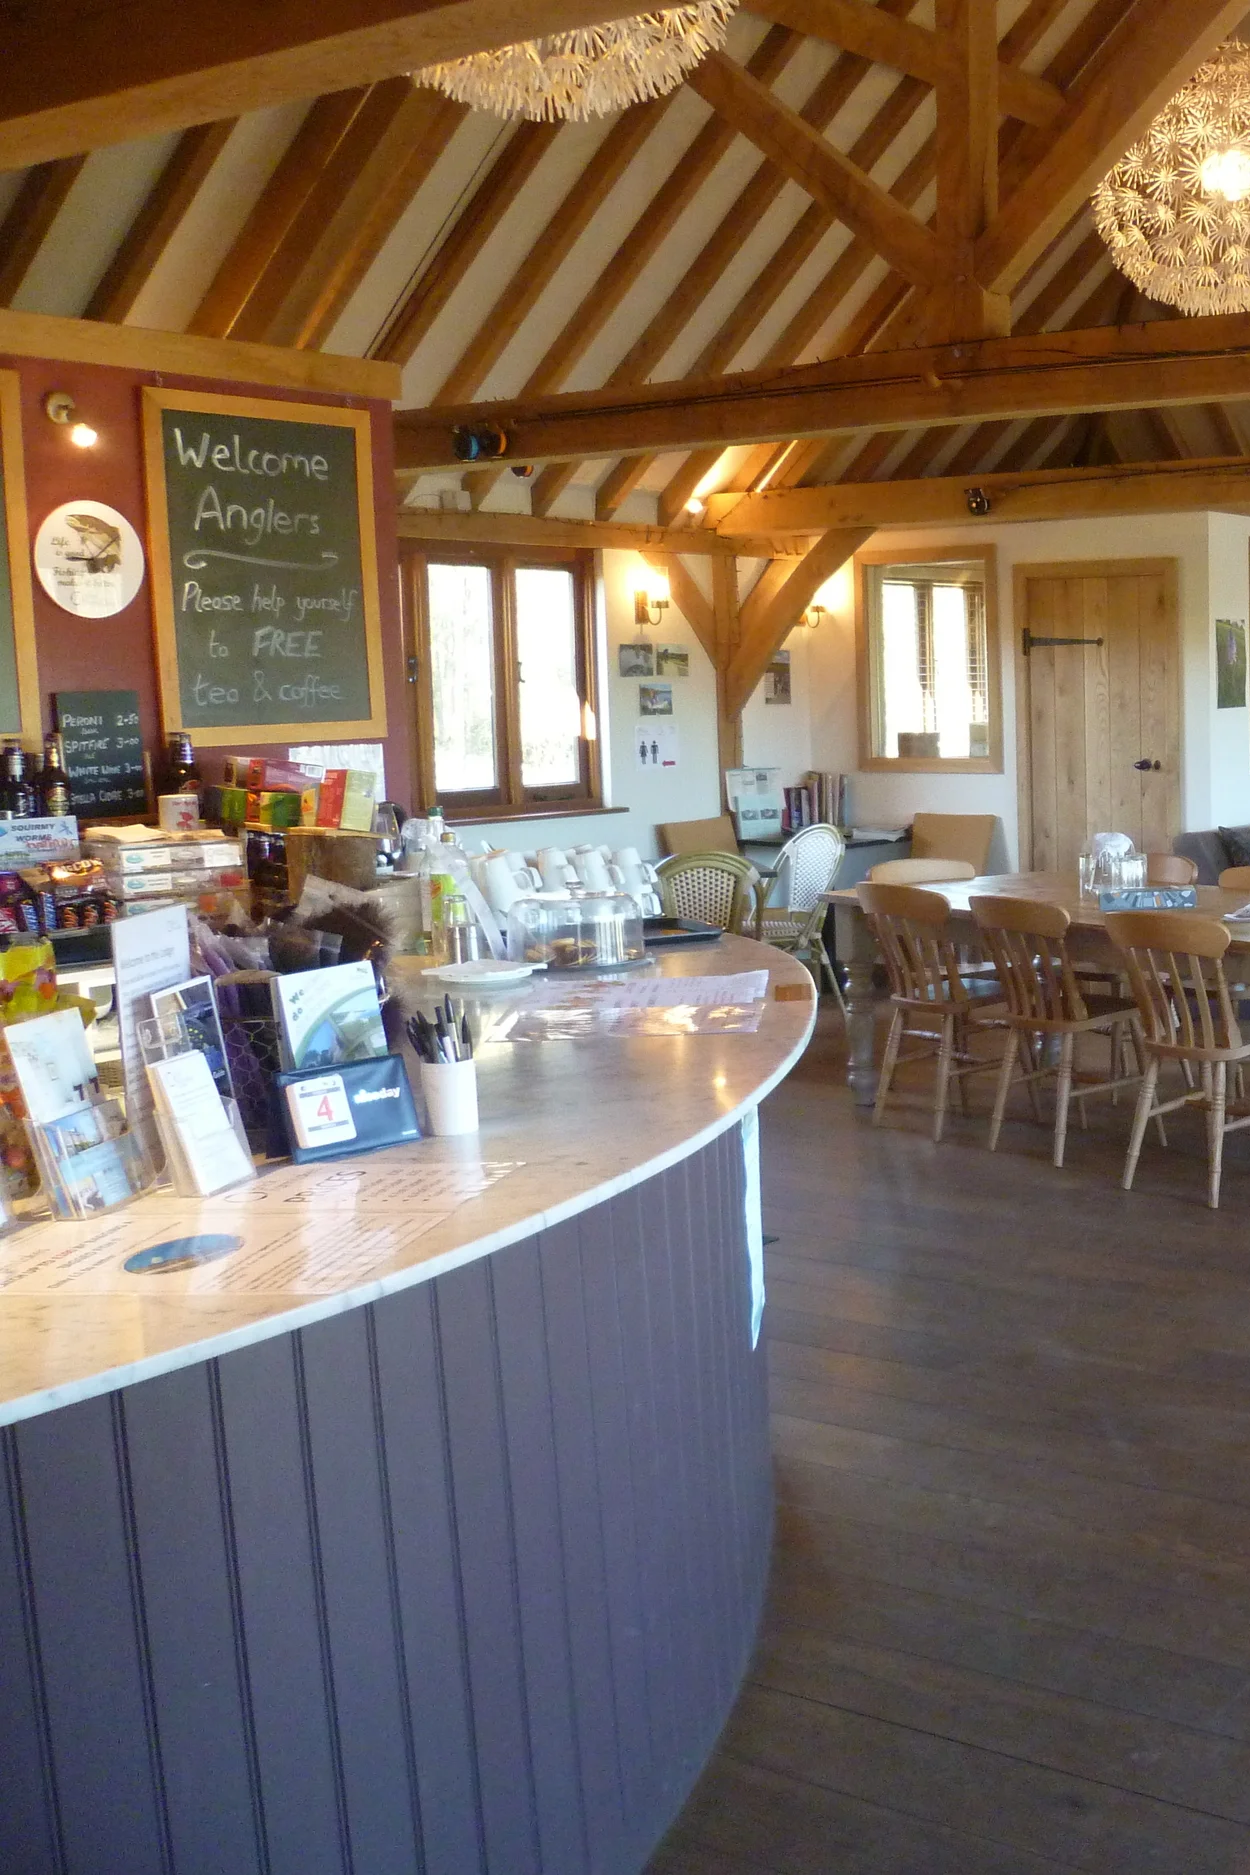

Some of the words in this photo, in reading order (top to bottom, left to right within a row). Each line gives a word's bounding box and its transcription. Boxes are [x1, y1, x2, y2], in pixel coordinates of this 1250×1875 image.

[174, 427, 329, 481] Welcome
[194, 485, 321, 546] Anglers
[182, 581, 244, 613] Please
[252, 584, 285, 617] help
[295, 588, 358, 622] yourself
[209, 629, 229, 658] to
[252, 625, 323, 657] FREE
[191, 674, 239, 706] tea
[253, 670, 272, 702] &
[279, 674, 341, 707] coffee
[62, 714, 103, 728] PERONI
[64, 738, 110, 753] SPITFIRE
[68, 766, 99, 777] WHITE
[11, 824, 55, 832] SQUIRMY
[16, 834, 53, 842] WORMS
[316, 1095, 334, 1121] 4
